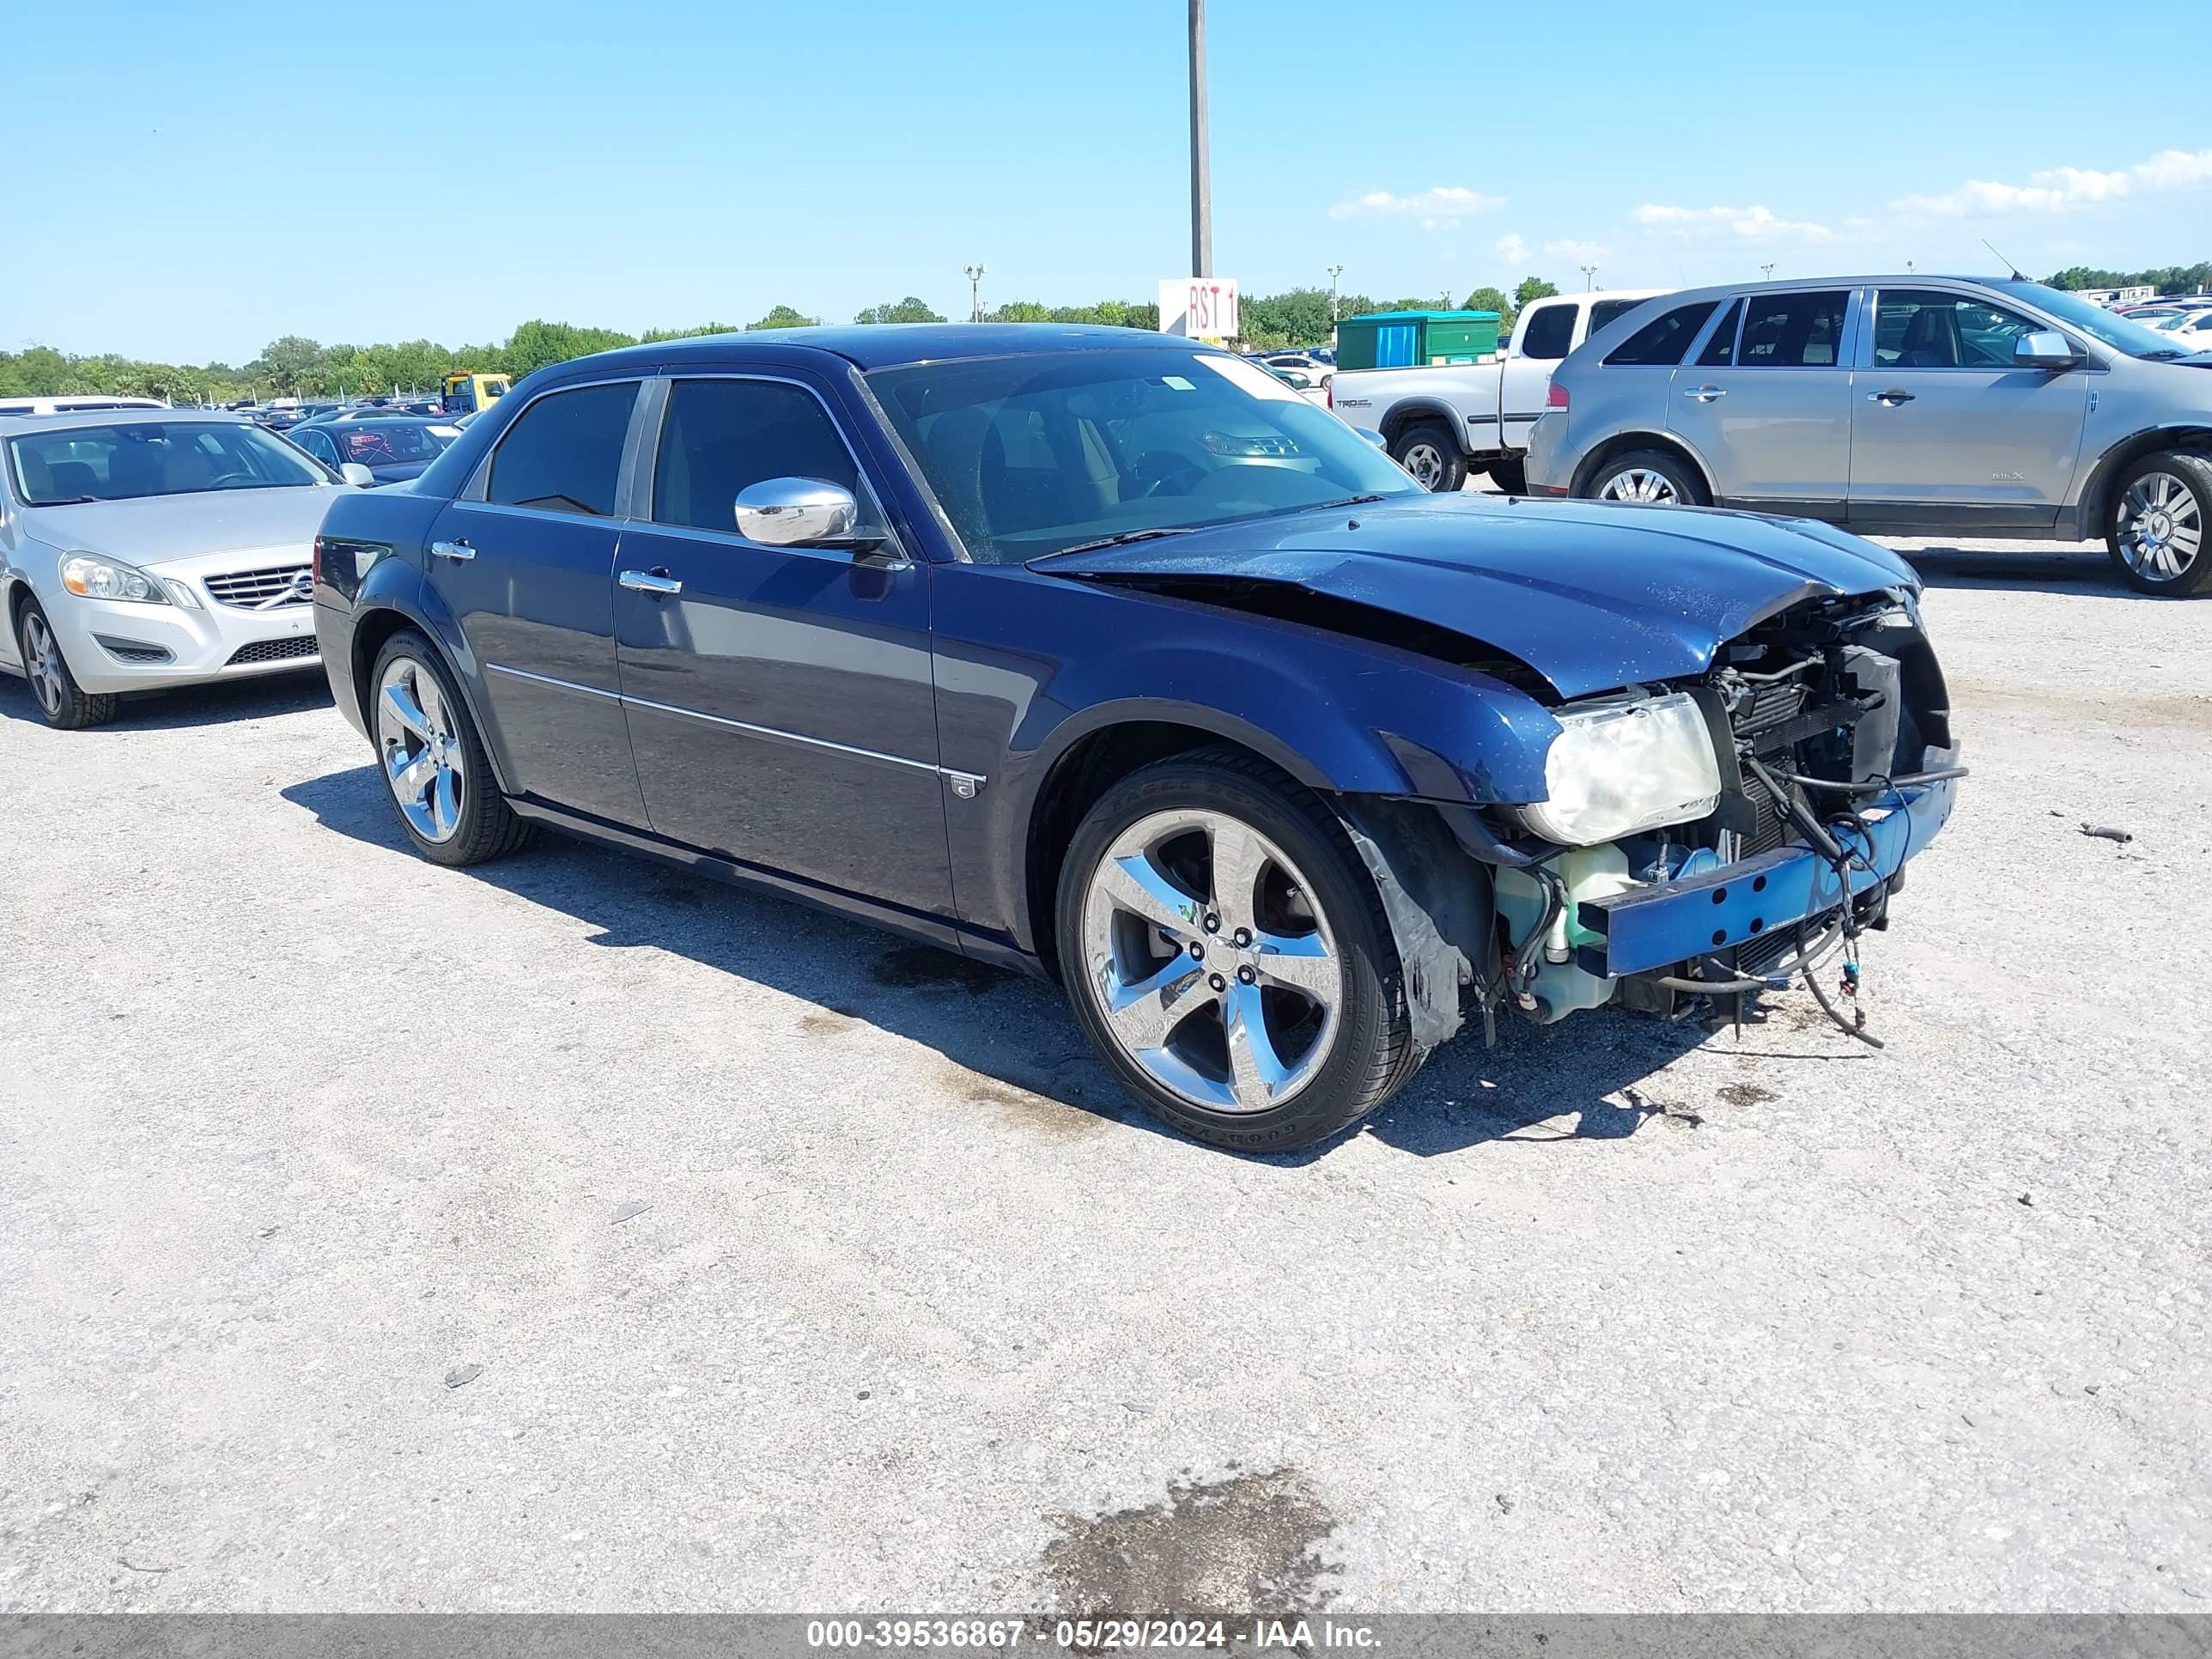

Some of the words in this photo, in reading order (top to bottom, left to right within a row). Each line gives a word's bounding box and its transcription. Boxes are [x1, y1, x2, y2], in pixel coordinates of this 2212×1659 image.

[1189, 285, 1220, 330] RST
[1336, 398, 1357, 408] TRD
[958, 786, 968, 795] C
